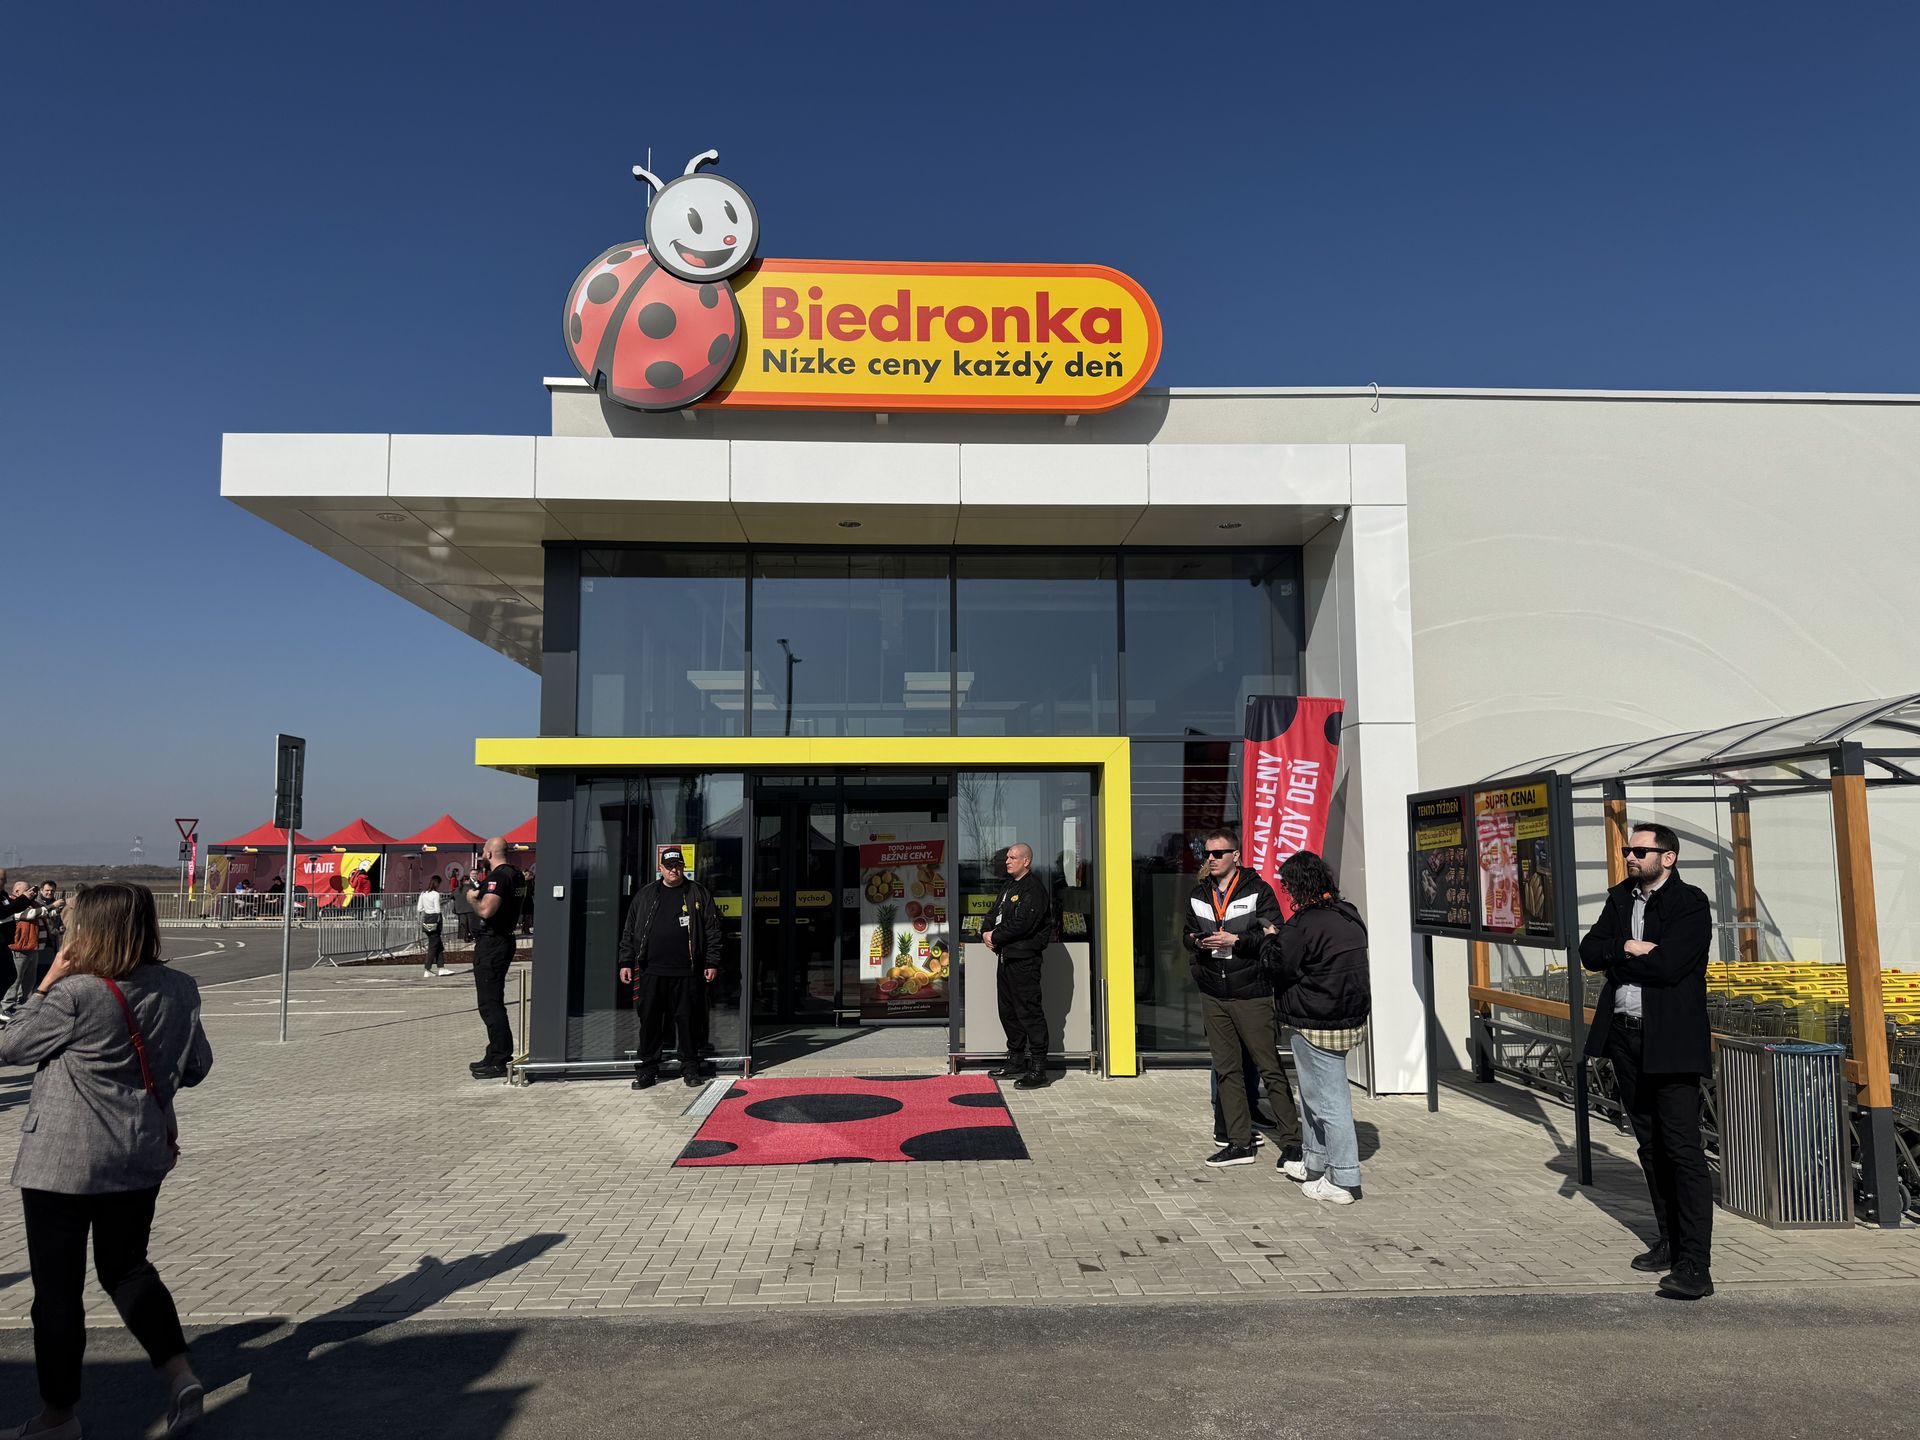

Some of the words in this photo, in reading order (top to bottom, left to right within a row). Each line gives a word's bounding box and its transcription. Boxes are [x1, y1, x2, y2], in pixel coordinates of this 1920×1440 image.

[763, 285, 1122, 345] Biedronka
[764, 348, 855, 375] Nízke
[869, 359, 941, 383] ceny
[953, 350, 1054, 384] každý
[1065, 351, 1123, 378] deň
[1254, 750, 1283, 808] CENY
[1286, 758, 1320, 805] DEŇ
[1417, 804, 1435, 817] TENTO
[1436, 798, 1459, 816] TÝŽDEŇ
[1485, 793, 1508, 810] SUPER
[1510, 789, 1536, 806] CENA!
[881, 851, 908, 861] BEŽNÉ
